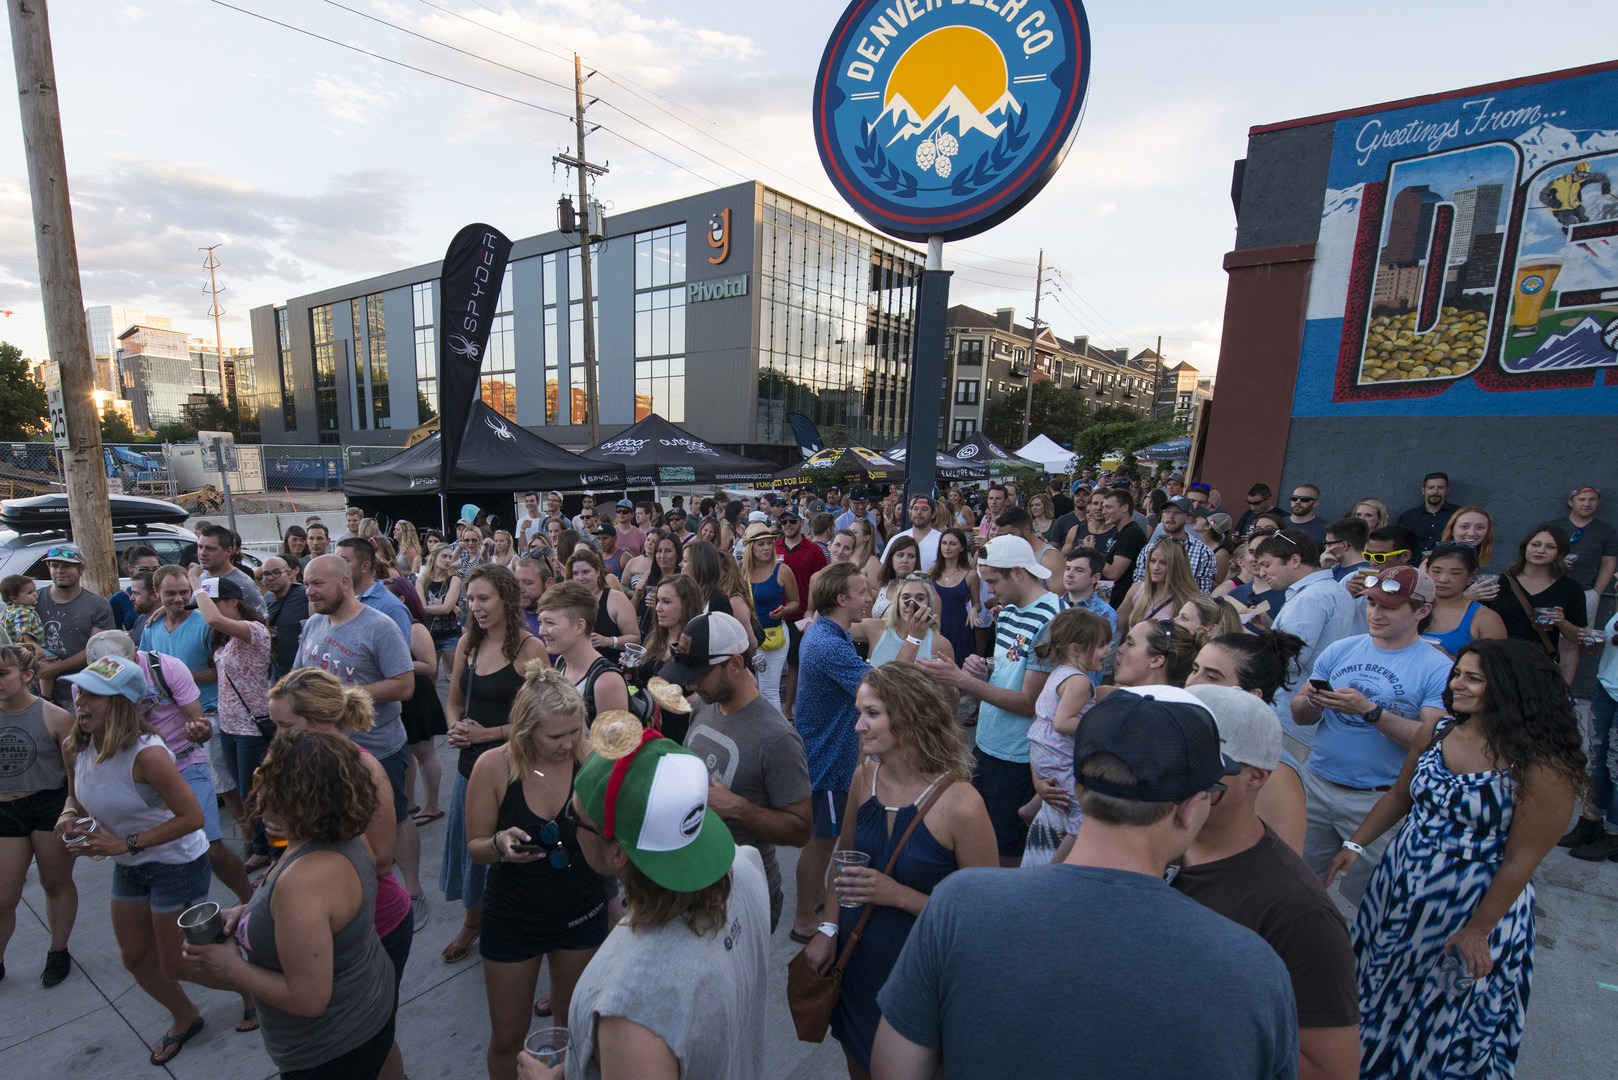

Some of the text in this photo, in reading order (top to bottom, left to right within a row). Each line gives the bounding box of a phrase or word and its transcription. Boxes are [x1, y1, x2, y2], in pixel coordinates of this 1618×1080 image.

[1356, 119, 1460, 166] Greetings
[463, 231, 498, 333] SPYDER
[687, 273, 748, 304] Pivotal
[51, 407, 66, 439] 25
[587, 474, 619, 482] SPYDER
[715, 472, 773, 481] www.outdoorproject.com
[784, 477, 798, 486] FOR
[1331, 664, 1363, 681] SUMMIT
[1365, 663, 1399, 684] BREWING
